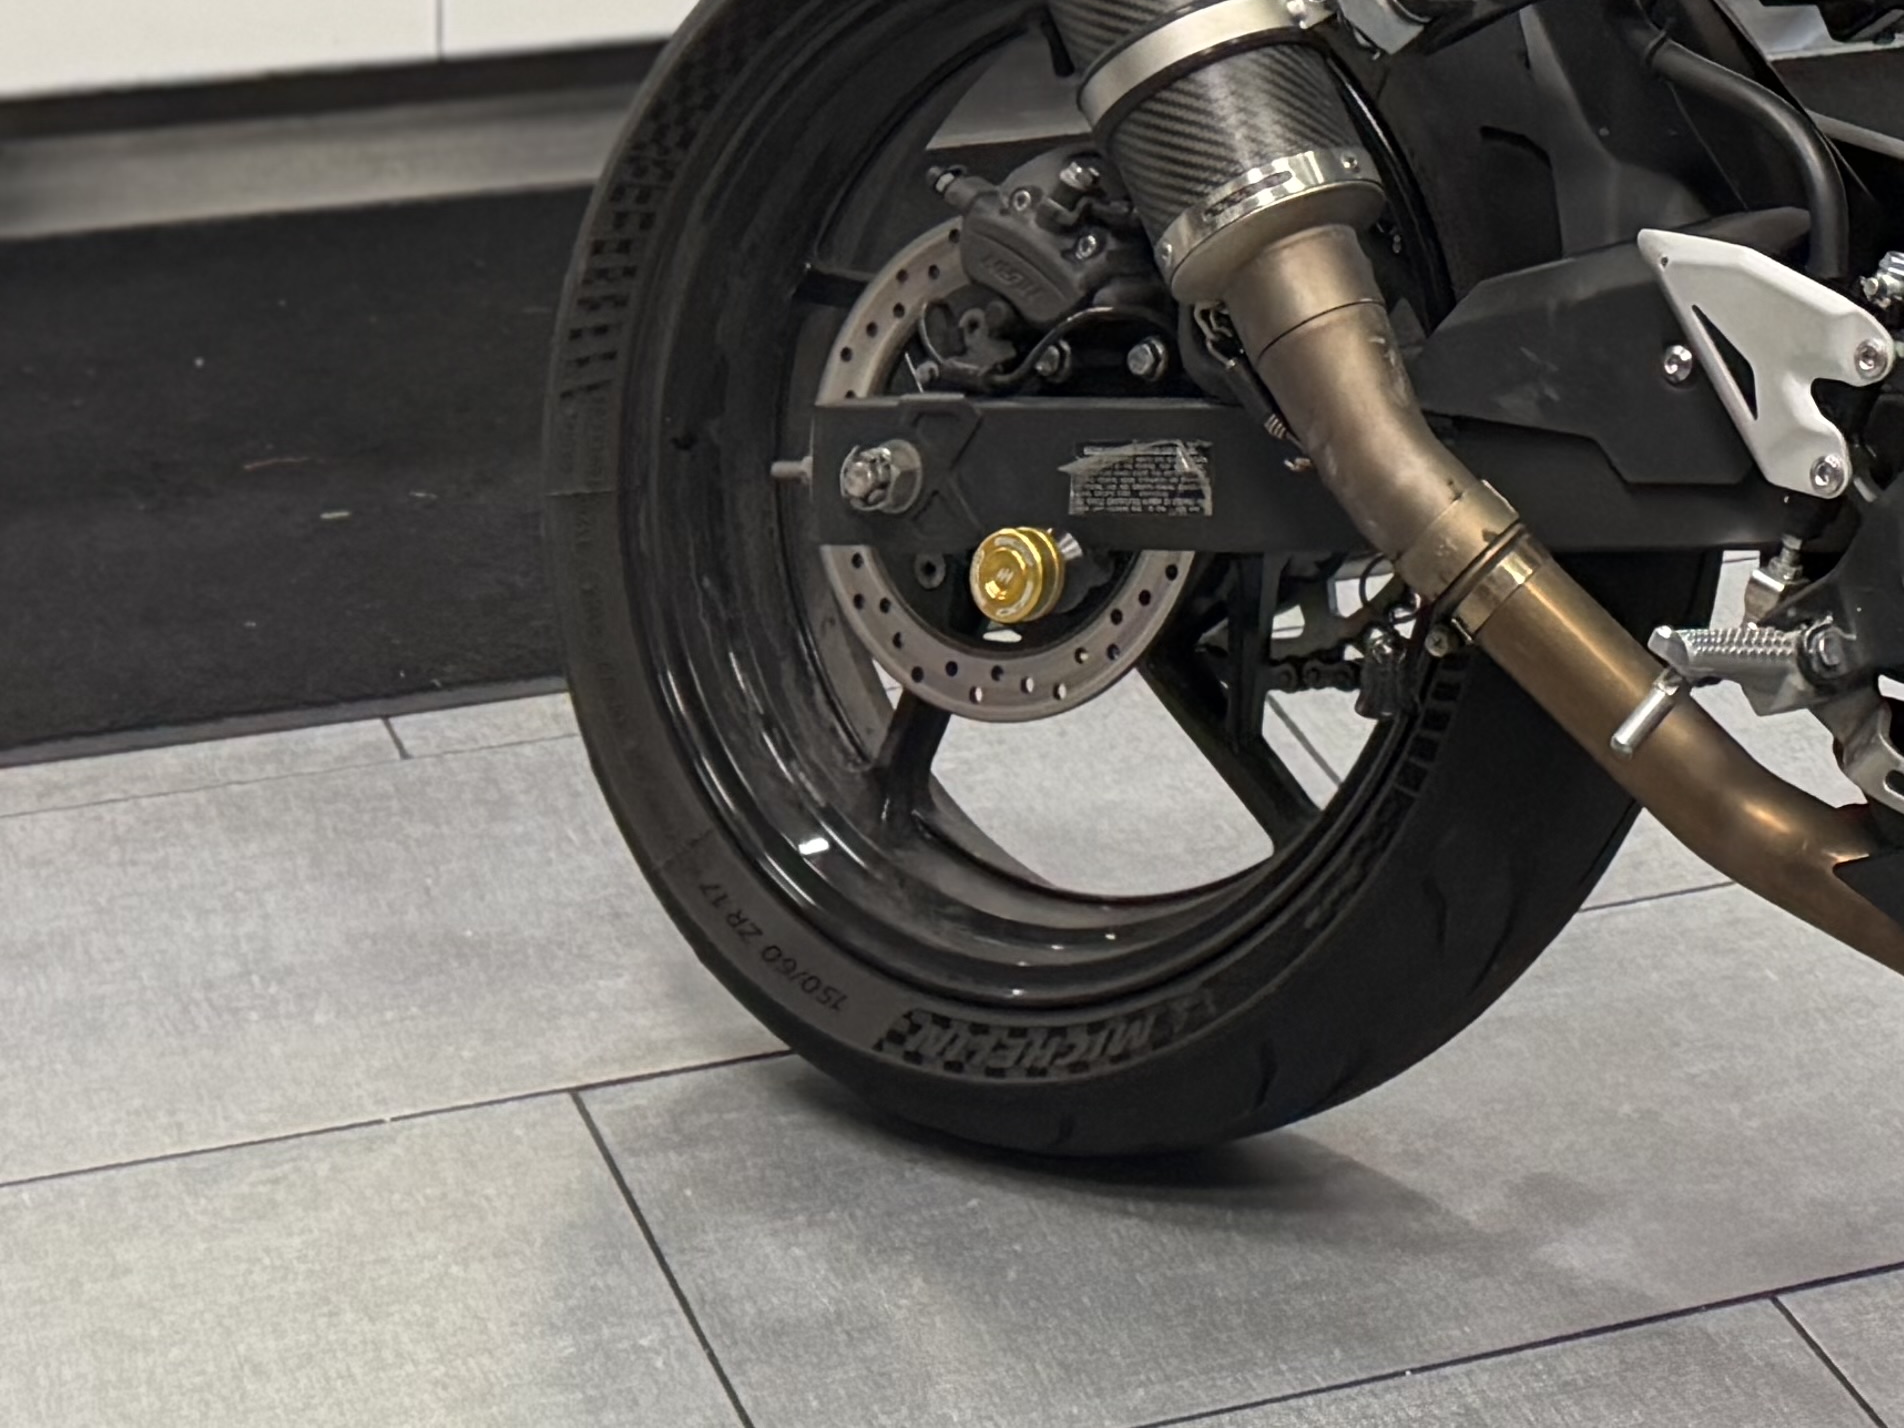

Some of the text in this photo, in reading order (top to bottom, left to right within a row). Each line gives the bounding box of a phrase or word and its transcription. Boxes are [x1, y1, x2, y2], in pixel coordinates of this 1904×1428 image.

[700, 879, 847, 1014] 150/60 ZR 17
[904, 1010, 1156, 1071] MICHELIN
